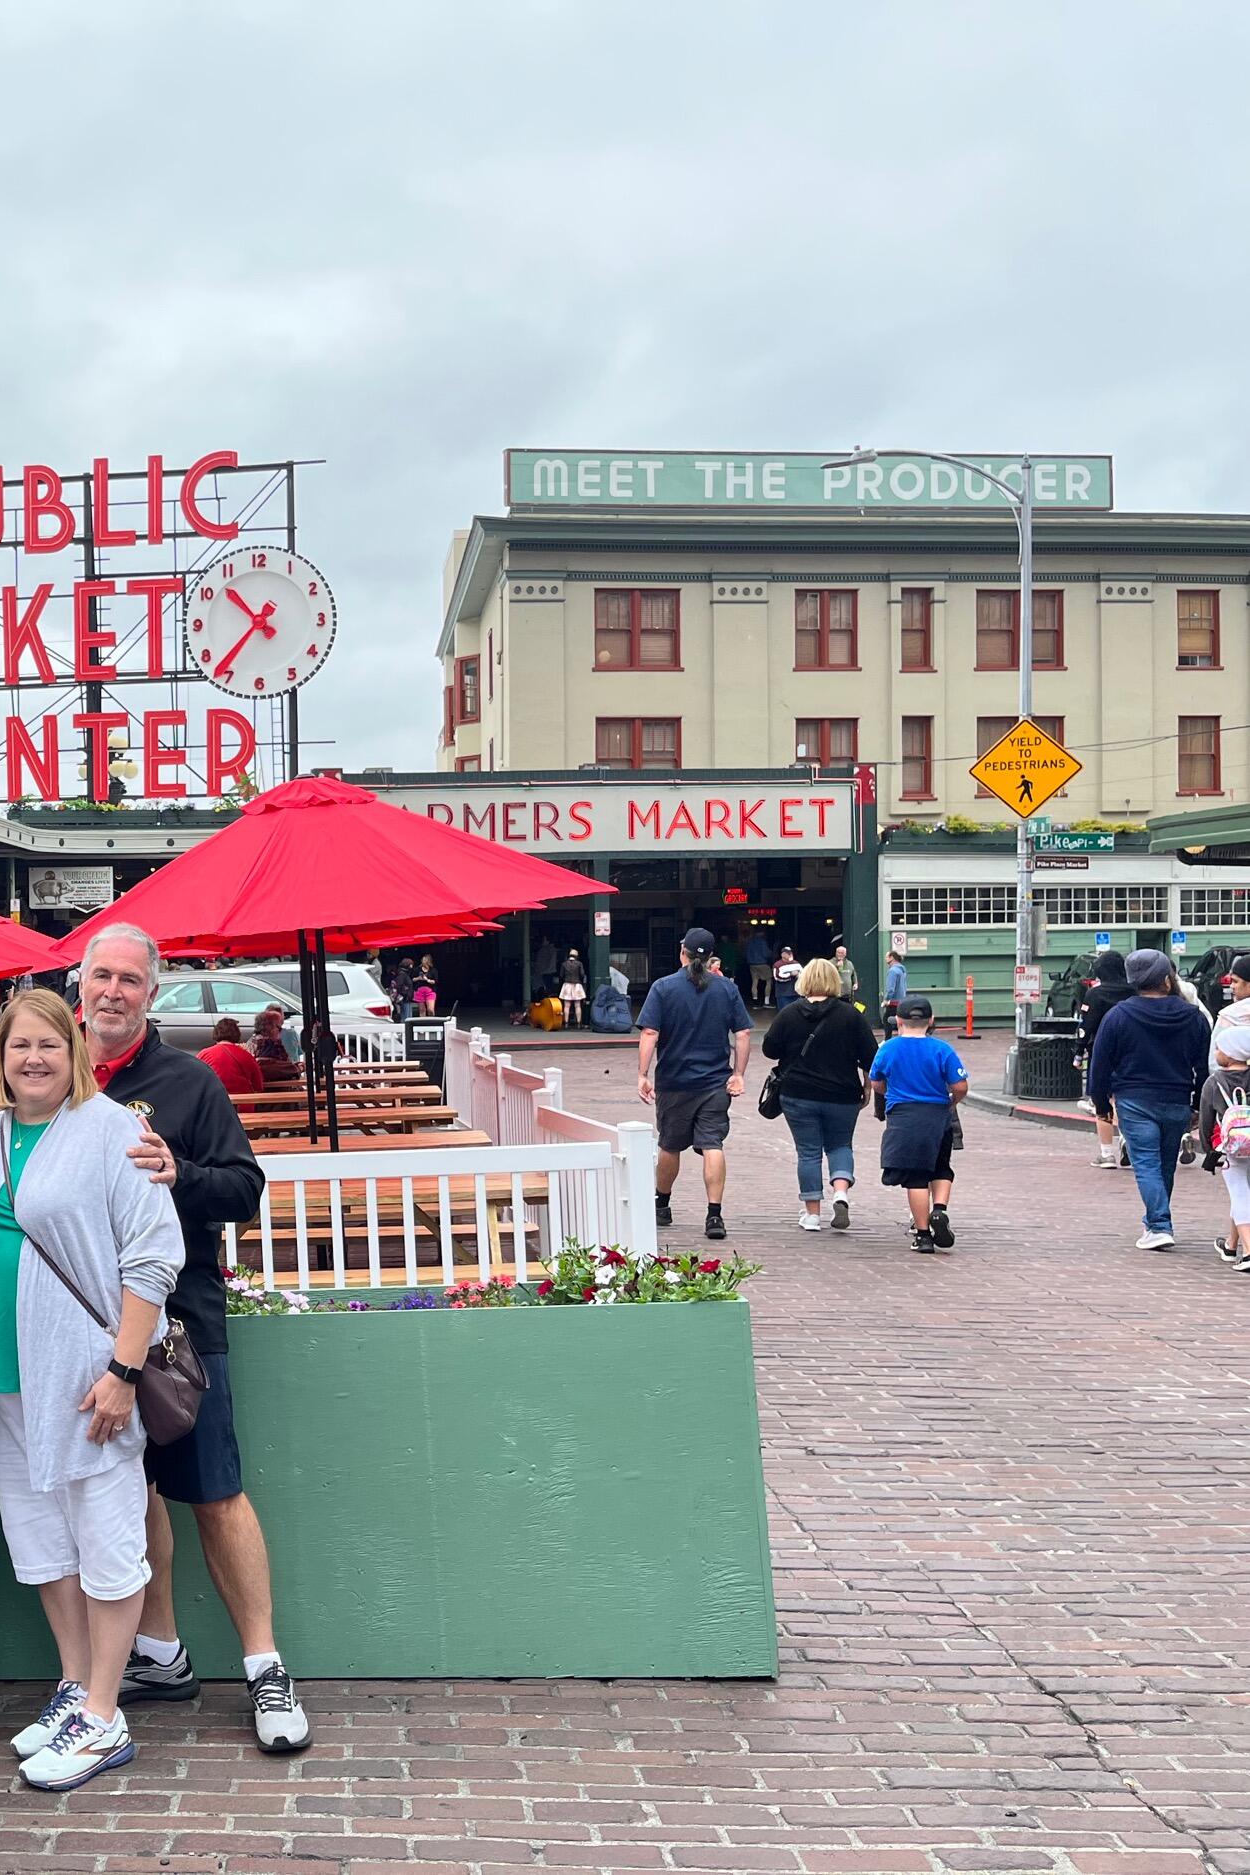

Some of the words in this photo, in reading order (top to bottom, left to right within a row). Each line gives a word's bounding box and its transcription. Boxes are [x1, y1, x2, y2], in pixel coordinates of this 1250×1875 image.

[533, 458, 664, 497] MEET
[694, 461, 786, 499] THE
[823, 463, 1092, 501] PRODUCER
[252, 553, 267, 568] 12
[287, 560, 292, 575] 1
[222, 563, 233, 578] 11
[200, 587, 214, 601] 10
[308, 582, 318, 596] 2
[192, 618, 203, 632] 9
[316, 612, 326, 627] 3
[201, 648, 212, 663] 8
[306, 644, 318, 658] 4
[224, 670, 234, 684] 7
[287, 667, 297, 681] 5
[254, 677, 265, 690] 6
[1008, 736, 1042, 747] YIELD
[1018, 749, 1032, 758] TO
[984, 758, 1066, 771] PEDESTRIANS
[401, 801, 593, 842] RMERS
[628, 799, 835, 840] MARKET
[1039, 834, 1070, 849] Pike
